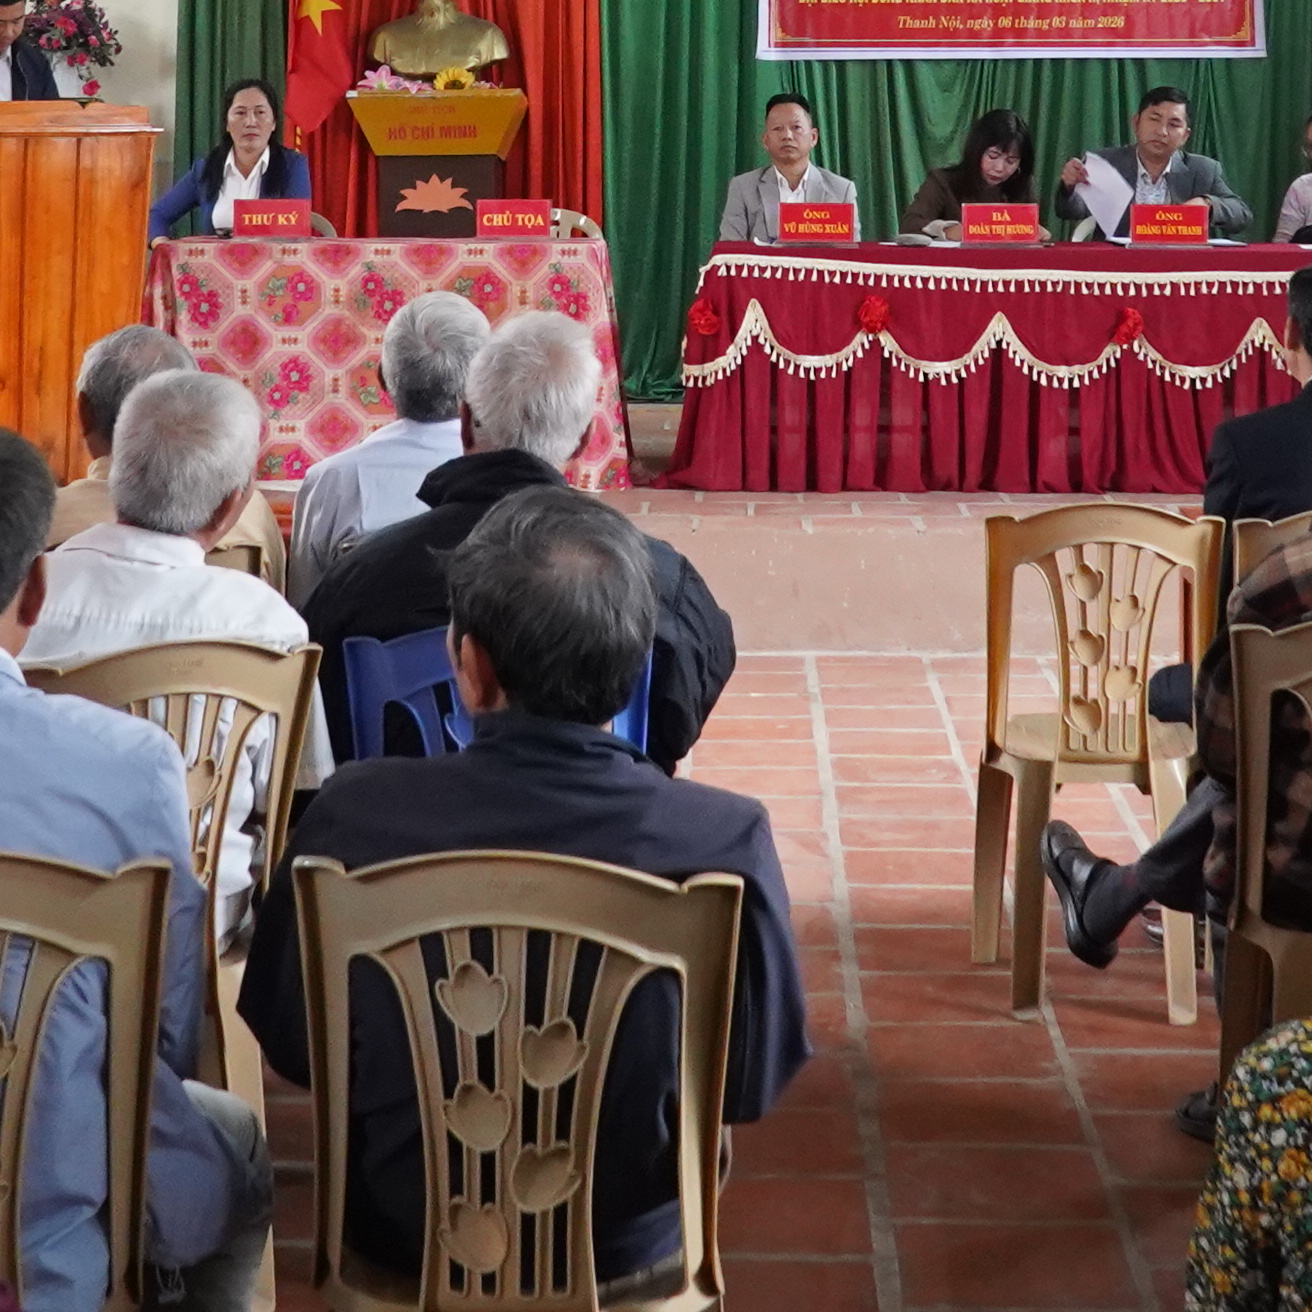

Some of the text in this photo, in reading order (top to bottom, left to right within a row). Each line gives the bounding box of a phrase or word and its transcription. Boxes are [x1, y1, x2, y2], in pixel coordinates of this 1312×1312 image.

[897, 16, 936, 28] Thanh
[939, 15, 964, 31] Nội,
[966, 16, 995, 31] ngày
[998, 16, 1013, 28] 06
[1015, 16, 1050, 30] tháng
[1068, 16, 1095, 28] năm
[1097, 16, 1125, 28] 2026
[439, 124, 478, 139] MINH
[242, 212, 299, 226] THƯ KÝ
[482, 210, 545, 229] CHỦ TỌA
[803, 208, 830, 219] ÔNG
[992, 209, 1011, 221] BÀ
[1155, 210, 1183, 220] ÔNG
[783, 221, 850, 233] VŨ HÙNG XUÂN
[991, 224, 1006, 236] THỊ
[1135, 222, 1161, 235] HOÀNG
[1178, 225, 1203, 235] THANH
